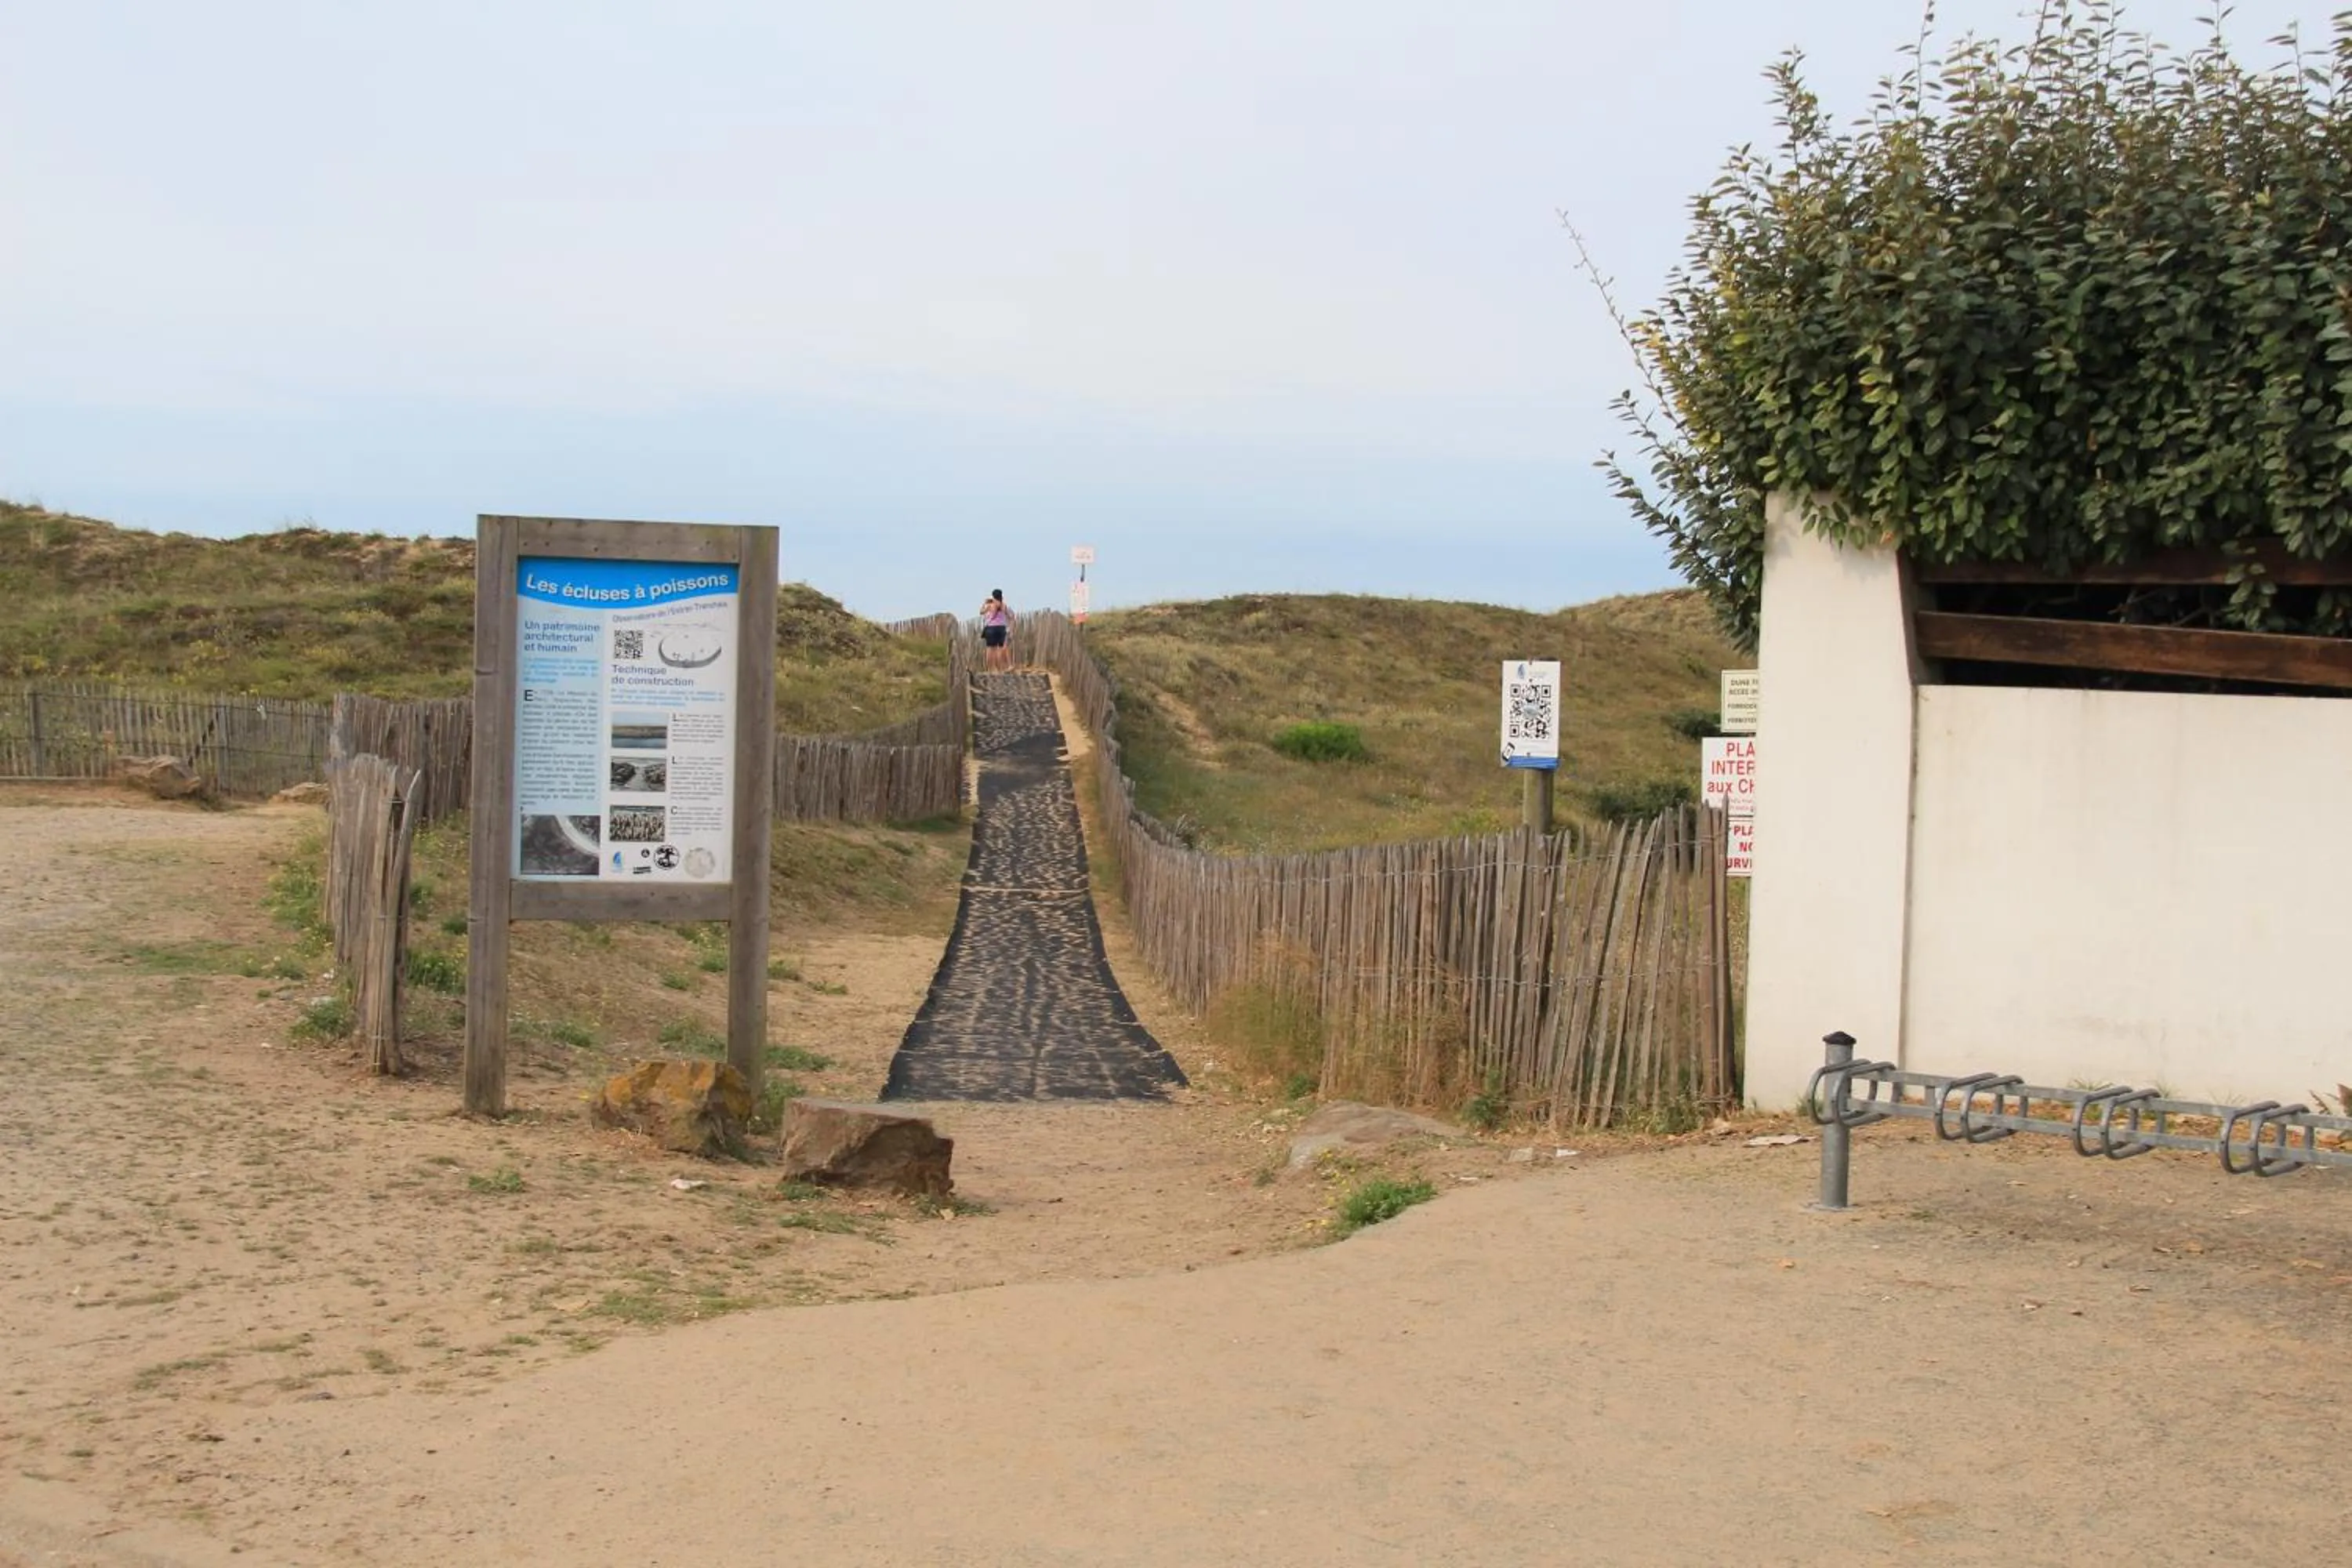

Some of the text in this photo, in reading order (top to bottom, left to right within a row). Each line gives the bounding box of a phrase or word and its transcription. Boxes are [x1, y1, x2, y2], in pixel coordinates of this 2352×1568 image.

[526, 573, 728, 601] Les écluses à poissons
[524, 620, 601, 633] Un patrimoine
[524, 632, 594, 642] architectural
[524, 643, 579, 652] et humain
[612, 664, 667, 676] Technique
[611, 675, 695, 687] de construction
[1726, 741, 1755, 757] PLA
[1707, 781, 1733, 793] aux
